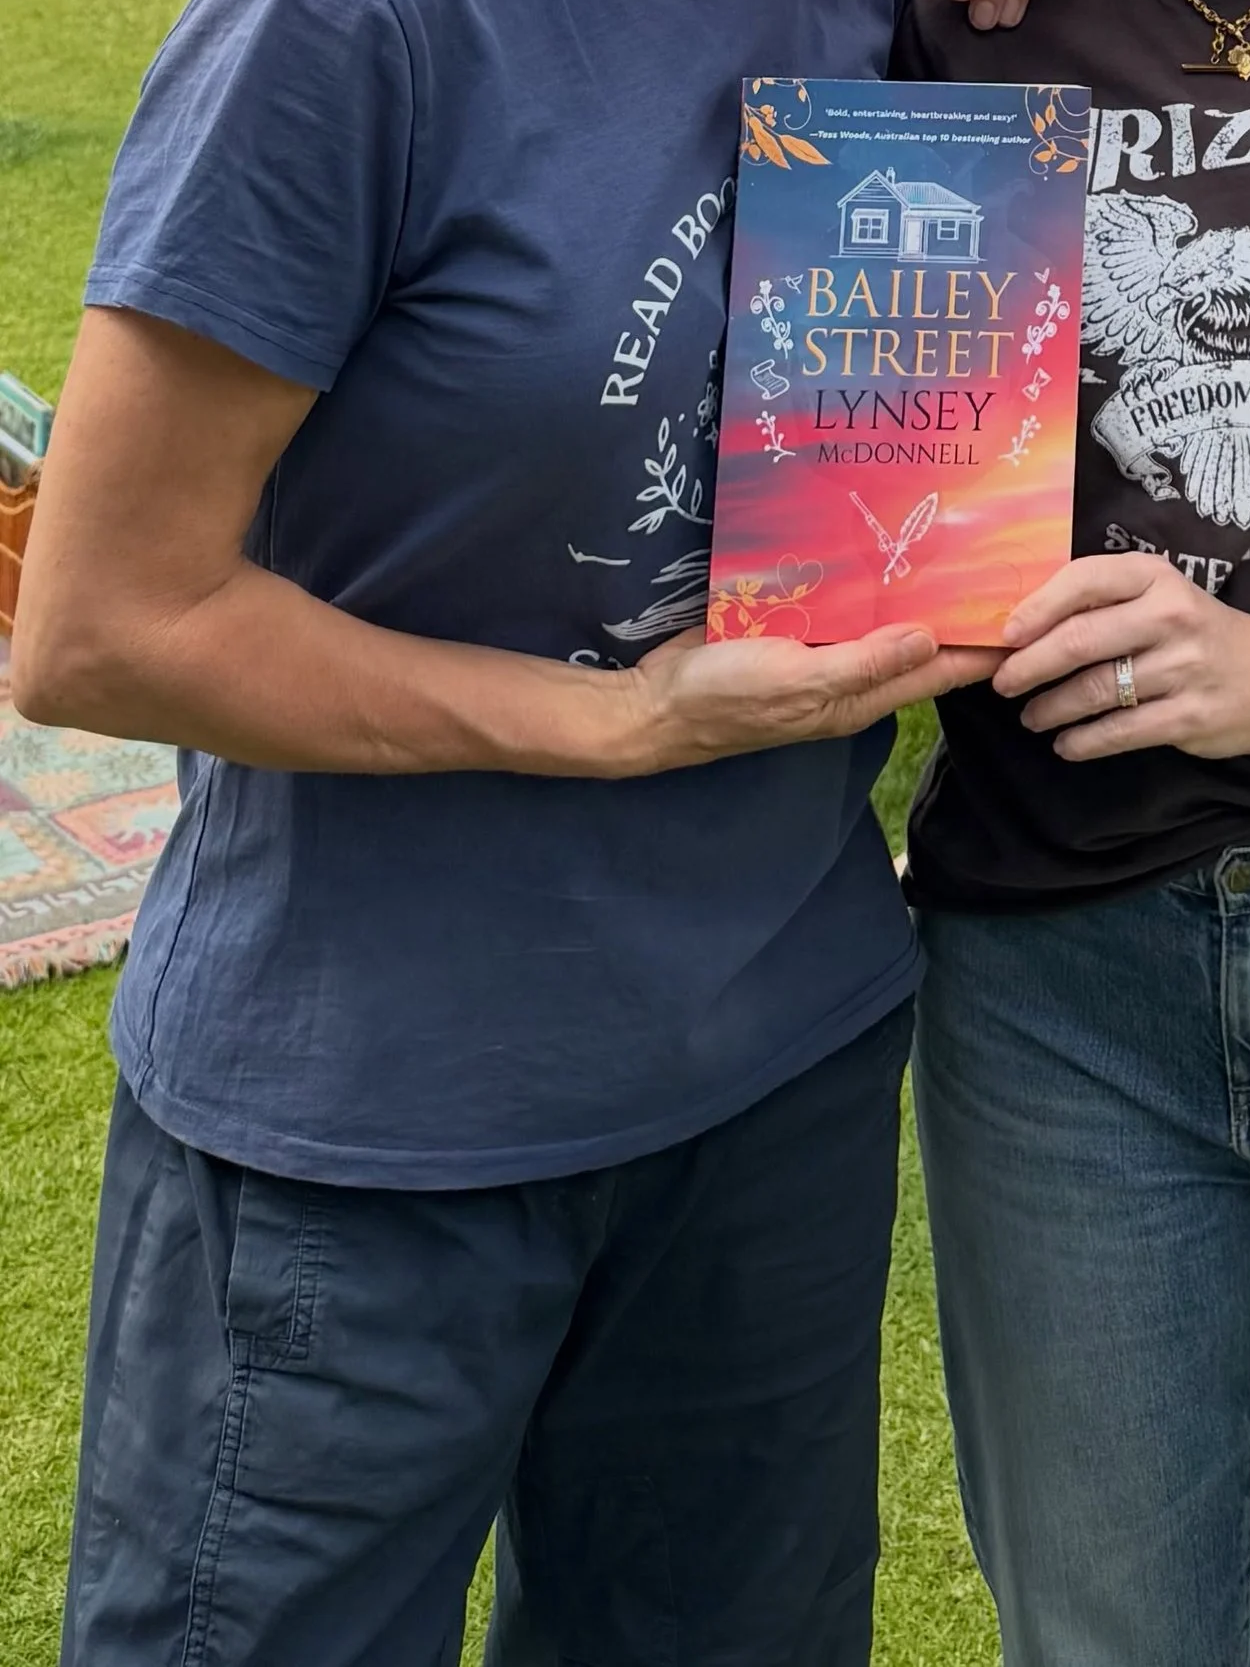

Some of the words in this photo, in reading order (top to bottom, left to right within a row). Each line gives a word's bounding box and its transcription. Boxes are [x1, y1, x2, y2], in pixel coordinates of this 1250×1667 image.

[911, 110, 972, 122] heartbreaking
[973, 113, 990, 121] and
[874, 132, 920, 141] Australian
[922, 133, 938, 143] top
[952, 134, 1000, 145] bestselling
[1001, 135, 1032, 145] author
[806, 268, 1018, 320] BAILEY
[600, 256, 683, 407] READ
[802, 327, 1014, 378] STREET
[813, 389, 996, 431] LYNSEY
[817, 442, 979, 465] McDONNELL
